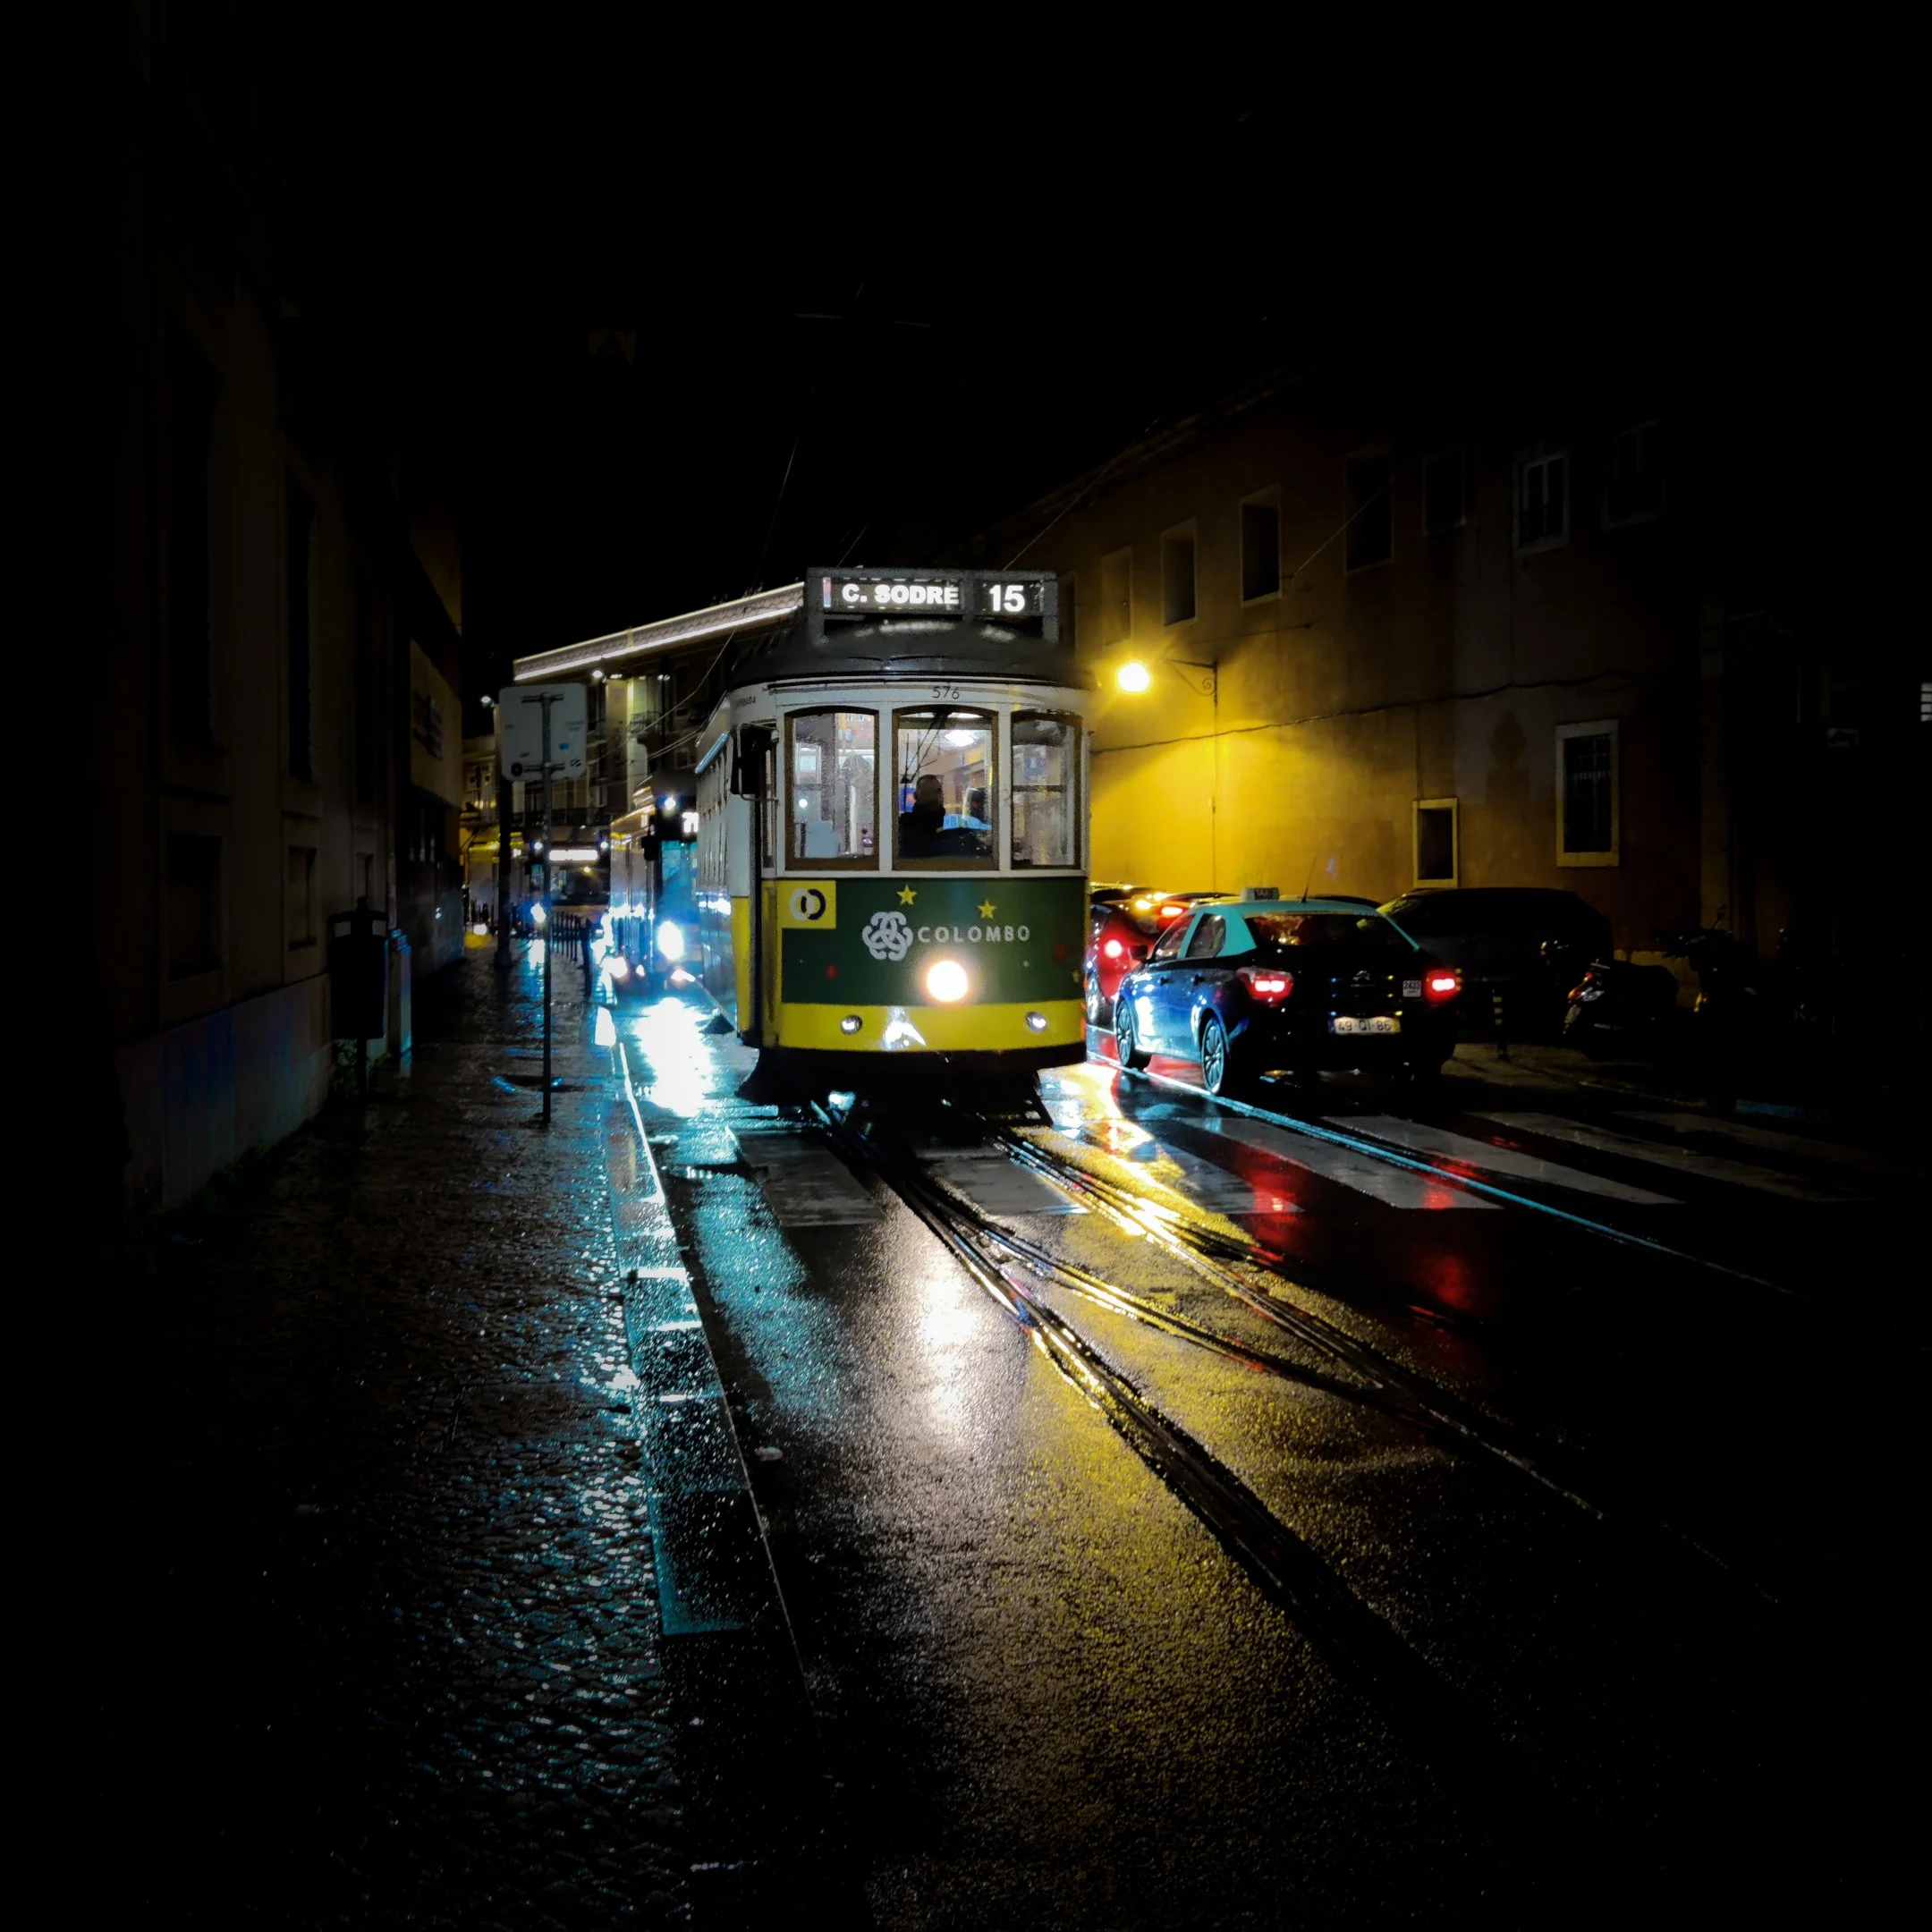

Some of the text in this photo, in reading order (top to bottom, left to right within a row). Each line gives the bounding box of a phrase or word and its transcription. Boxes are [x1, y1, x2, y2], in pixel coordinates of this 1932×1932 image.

[842, 584, 868, 604] C.
[988, 584, 1026, 613] 15
[932, 685, 960, 699] 576
[917, 925, 1030, 944] COLOMBO
